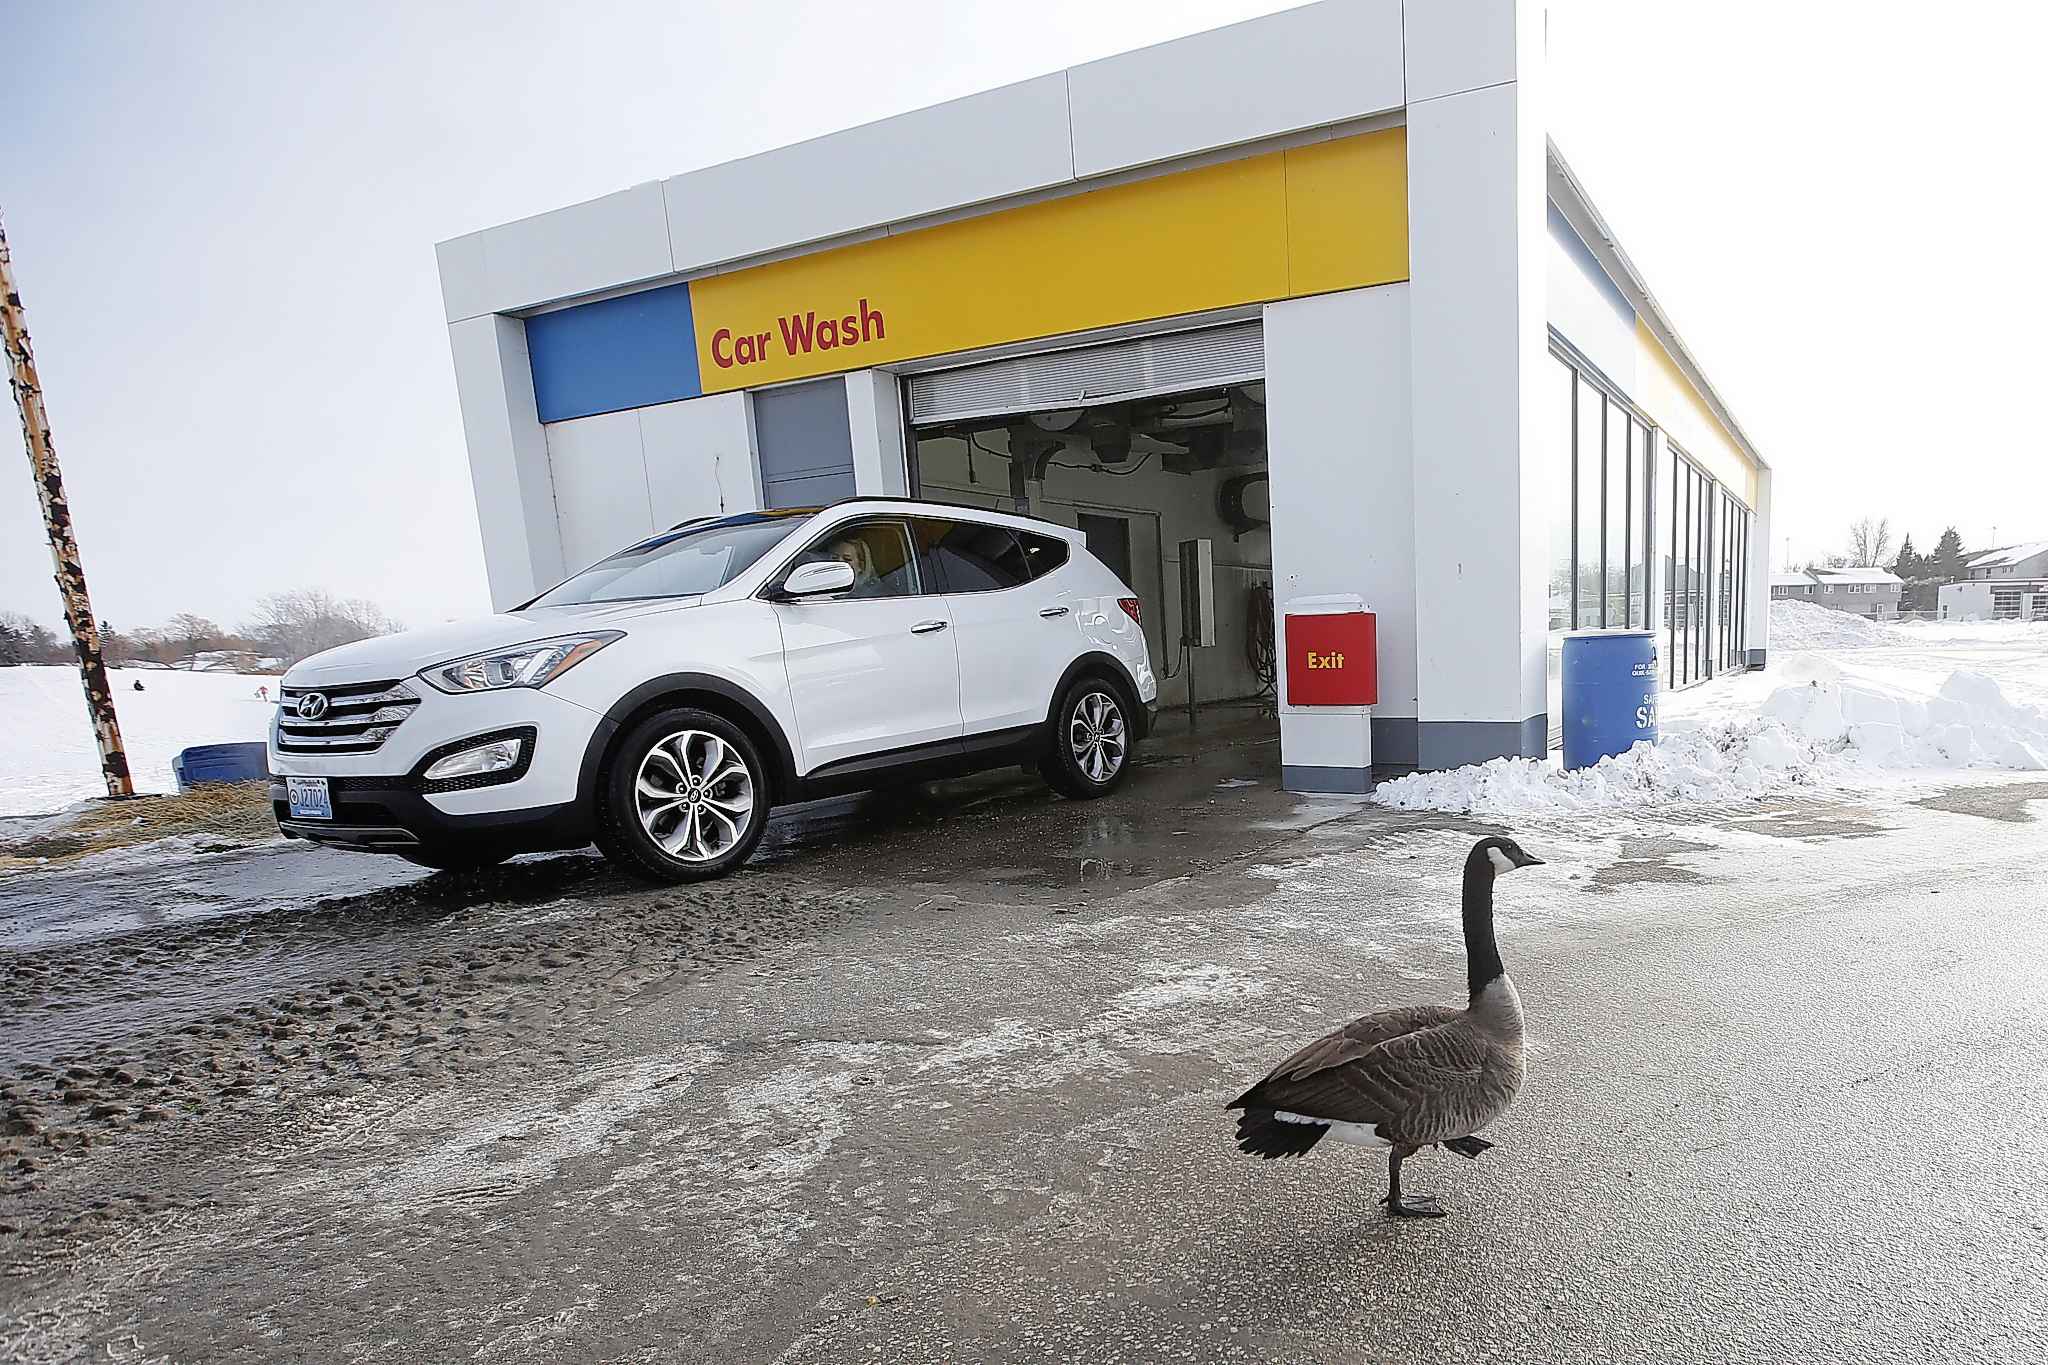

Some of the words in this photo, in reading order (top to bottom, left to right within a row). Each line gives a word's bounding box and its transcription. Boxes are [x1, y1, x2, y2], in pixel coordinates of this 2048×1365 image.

[711, 328, 771, 369] Car
[777, 298, 885, 356] Wash
[1307, 651, 1345, 669] Exit
